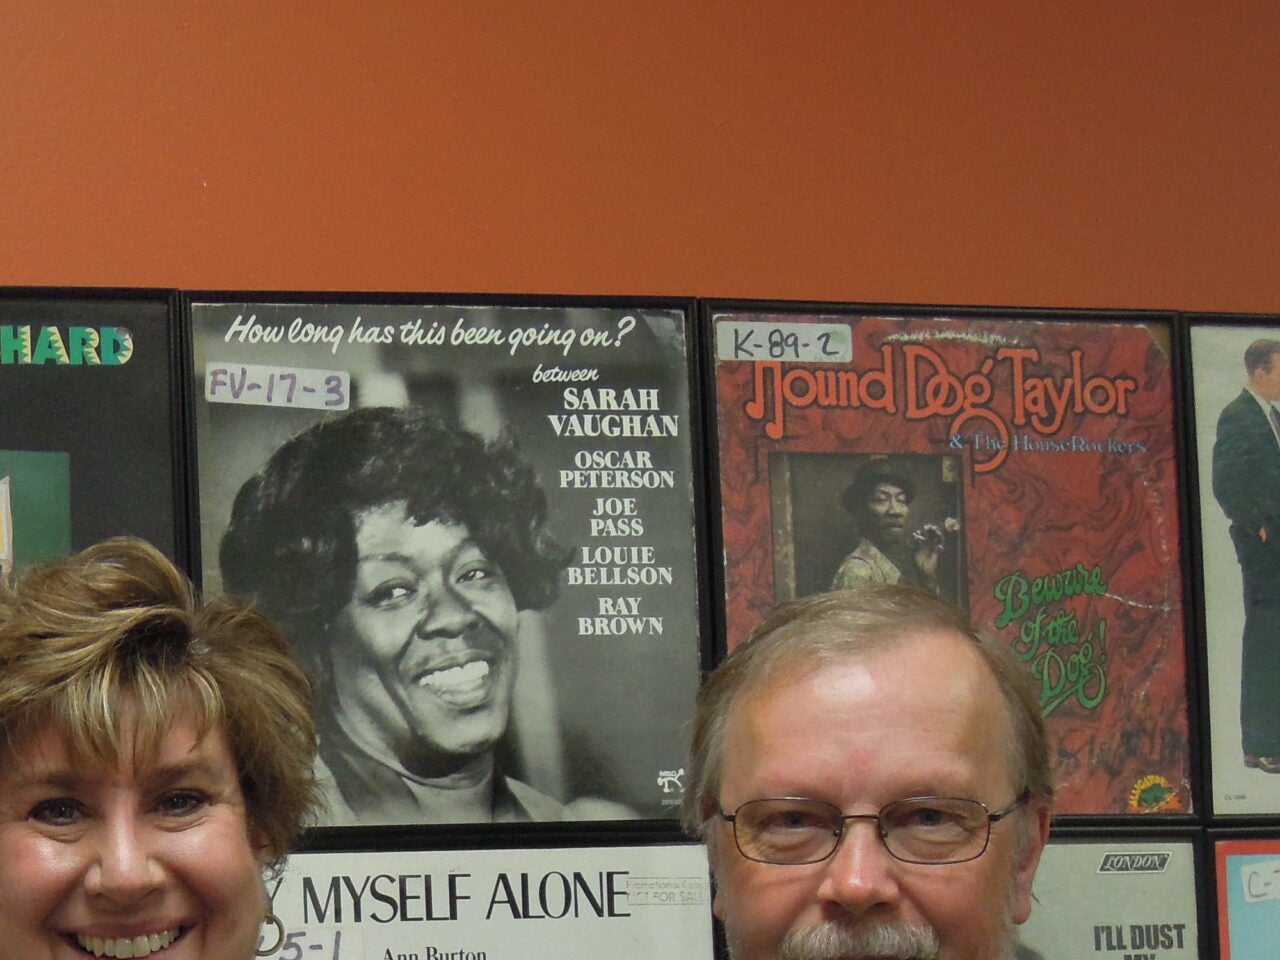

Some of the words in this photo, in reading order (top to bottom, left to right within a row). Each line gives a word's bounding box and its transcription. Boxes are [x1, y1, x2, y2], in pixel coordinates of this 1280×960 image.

[224, 315, 287, 345] How
[288, 318, 344, 354] long
[349, 316, 393, 345] has
[400, 318, 446, 346] this
[451, 319, 505, 347] been
[510, 328, 574, 356] going
[579, 316, 636, 348] on?
[733, 328, 839, 359] K-89-2
[532, 364, 599, 383] between
[209, 366, 345, 407] FV-17-3
[563, 387, 660, 411] SARAH
[904, 344, 1009, 473] Dog
[997, 347, 1136, 434] Taylor
[547, 414, 679, 437] VAUGHAN
[949, 432, 963, 449] &
[574, 450, 654, 469] OSCAR
[559, 470, 675, 489] PETERSON
[592, 498, 638, 516] JOE
[590, 518, 644, 537] PASS
[581, 546, 656, 564] LOUIE
[567, 567, 673, 585] BELLSON
[994, 562, 1107, 628] Beware
[597, 597, 643, 615] RAY
[577, 617, 664, 636] BROWN
[1011, 605, 1048, 661] of
[1046, 610, 1080, 645] the
[1104, 854, 1163, 871] LONDON
[1248, 870, 1280, 898] C-
[302, 873, 471, 925] MYSELF
[485, 870, 632, 921] ALONE
[1093, 925, 1126, 951] I'LL
[1130, 924, 1186, 950] DUST
